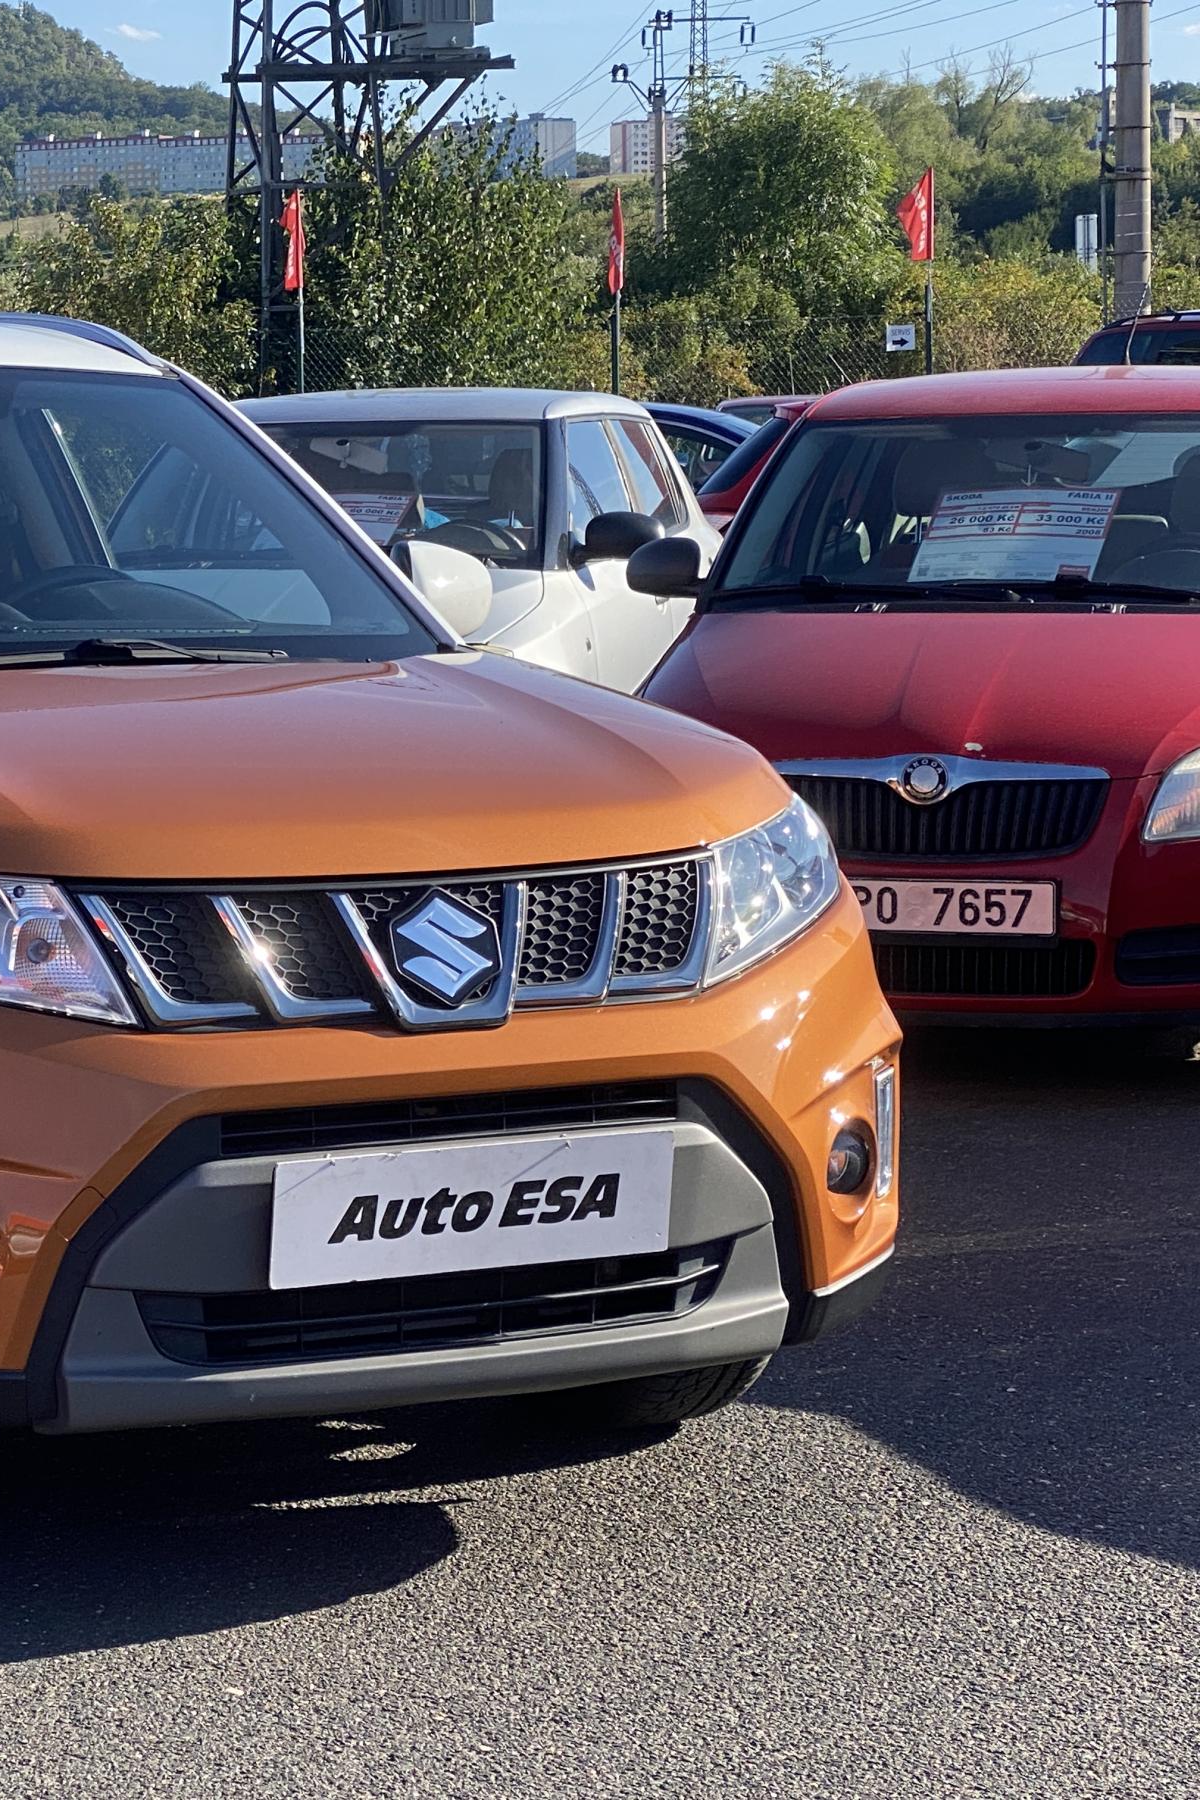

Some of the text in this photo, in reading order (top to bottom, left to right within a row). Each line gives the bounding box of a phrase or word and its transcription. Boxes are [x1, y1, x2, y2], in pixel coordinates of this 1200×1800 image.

[1067, 491, 1101, 500] FABIA
[949, 513, 1016, 525] 26 000 Kč
[1056, 515, 1082, 524] 000
[1086, 516, 1105, 525] Kč
[932, 886, 1033, 929] 7657
[326, 1173, 621, 1245] Auto ESA
